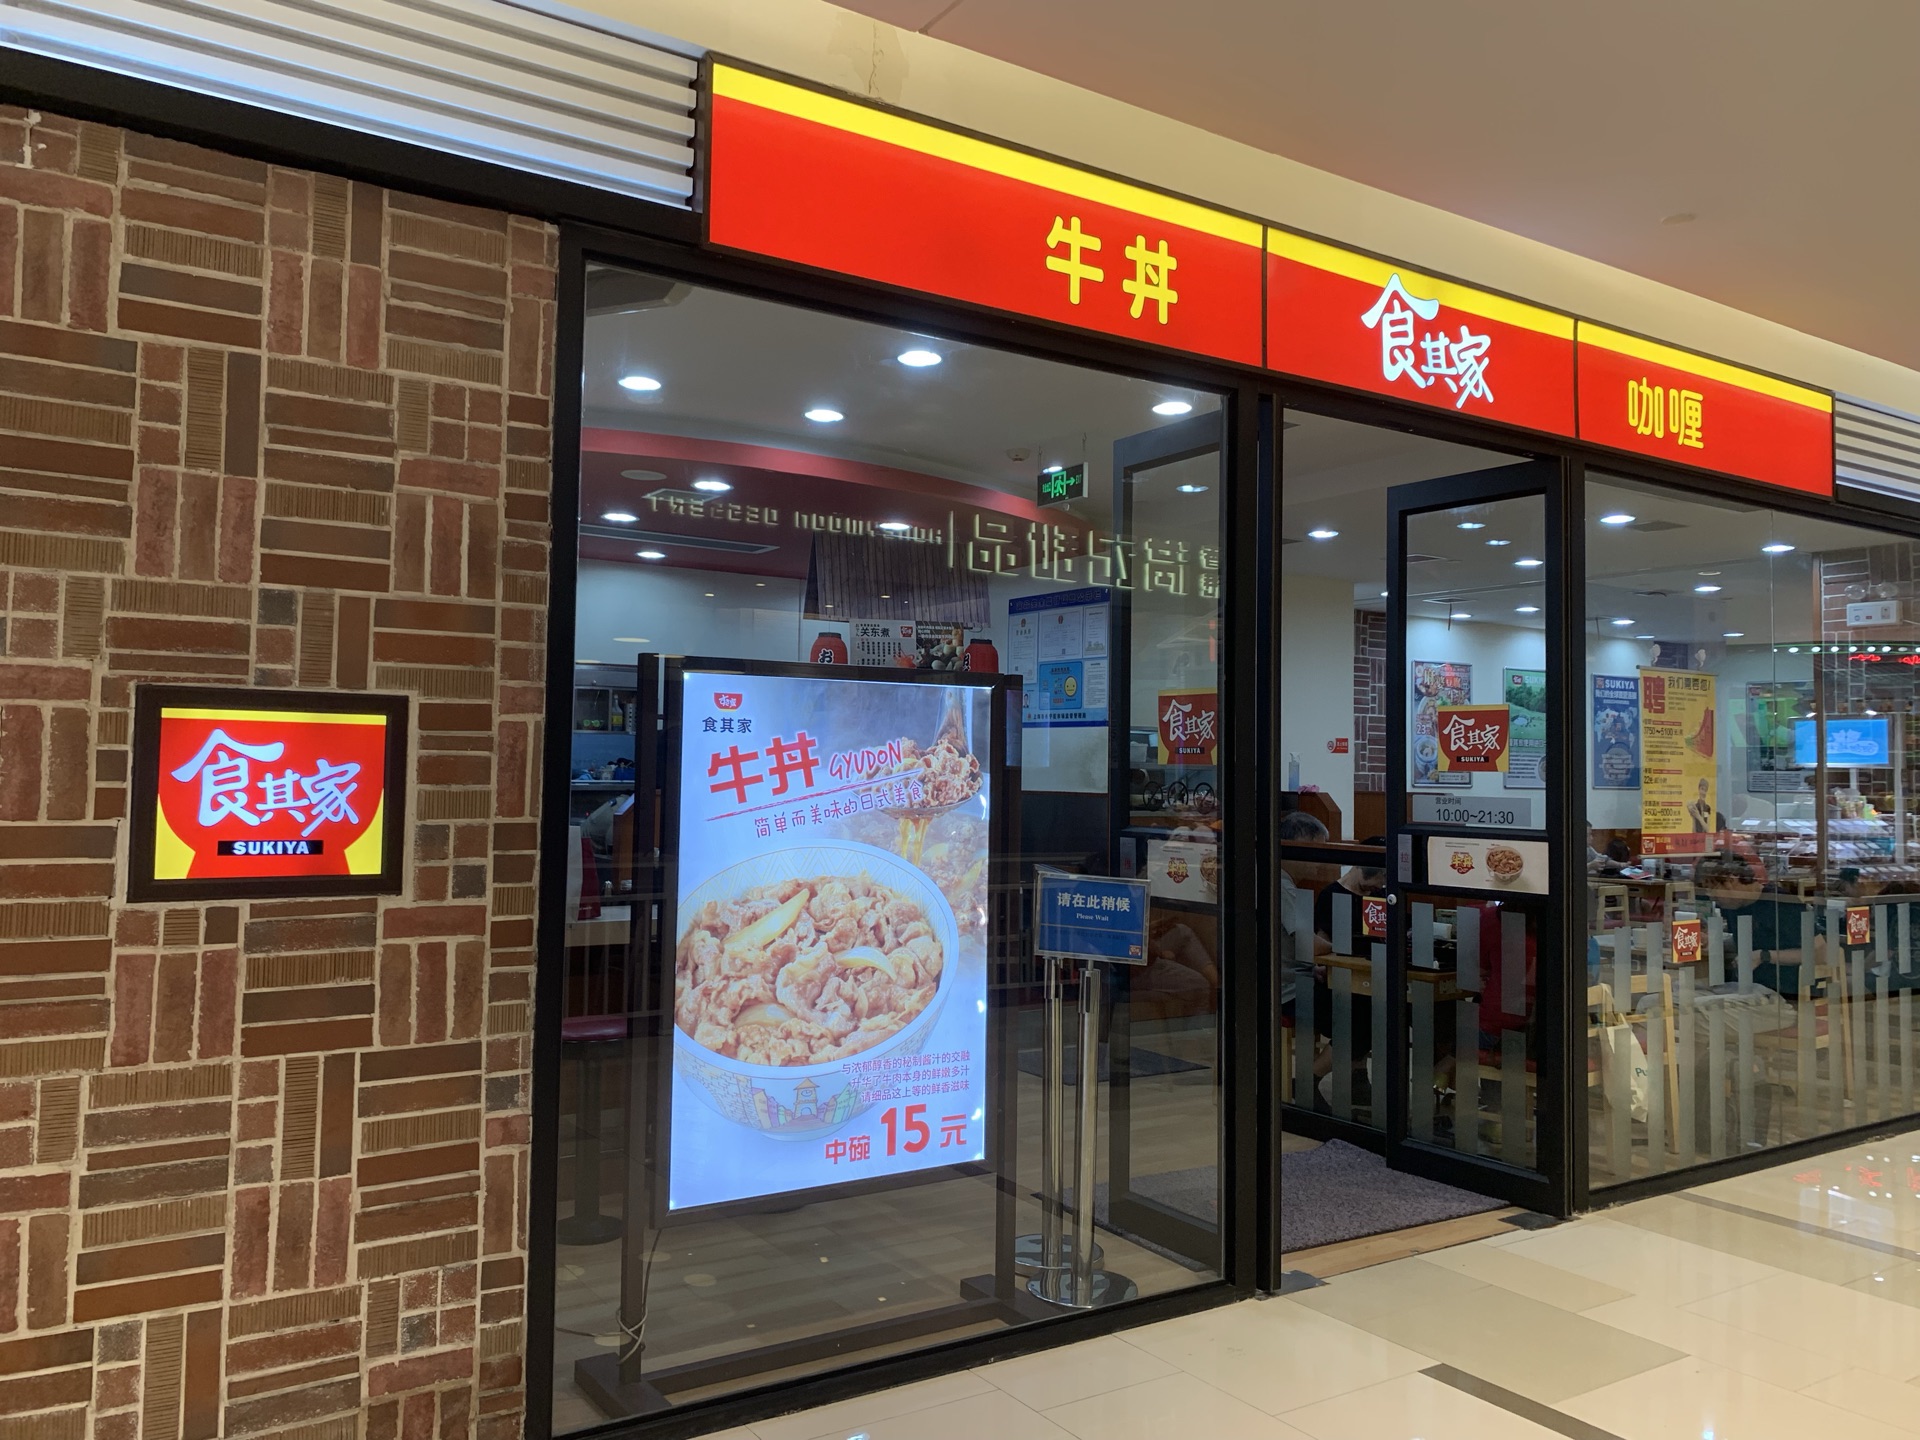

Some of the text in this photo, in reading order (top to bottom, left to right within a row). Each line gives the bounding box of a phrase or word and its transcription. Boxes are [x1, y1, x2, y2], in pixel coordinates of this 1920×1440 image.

[1045, 216, 1178, 326] 牛丼
[1361, 273, 1495, 409] 食其家
[1628, 379, 1704, 450] 咖喱
[860, 626, 890, 638] 关东煮
[1605, 679, 1635, 690] SUKIYA
[702, 716, 752, 734] 食其家
[1162, 698, 1215, 746] 食其家
[1442, 714, 1500, 756] 食其家
[707, 731, 820, 805] 牛丼
[829, 740, 902, 780] GYUDON
[170, 727, 362, 838] 食其家
[754, 779, 923, 839] 简单而美味的日式美食
[232, 840, 310, 855] SUKIYA
[1057, 891, 1131, 912] 请在此稍候
[1076, 912, 1109, 922] Please Wait
[851, 1064, 970, 1089] 升华了牛肉本身的鲜嫩多汁
[861, 1079, 970, 1103] 请细品这上等的鲜香滋味
[825, 1135, 871, 1165] 中碗
